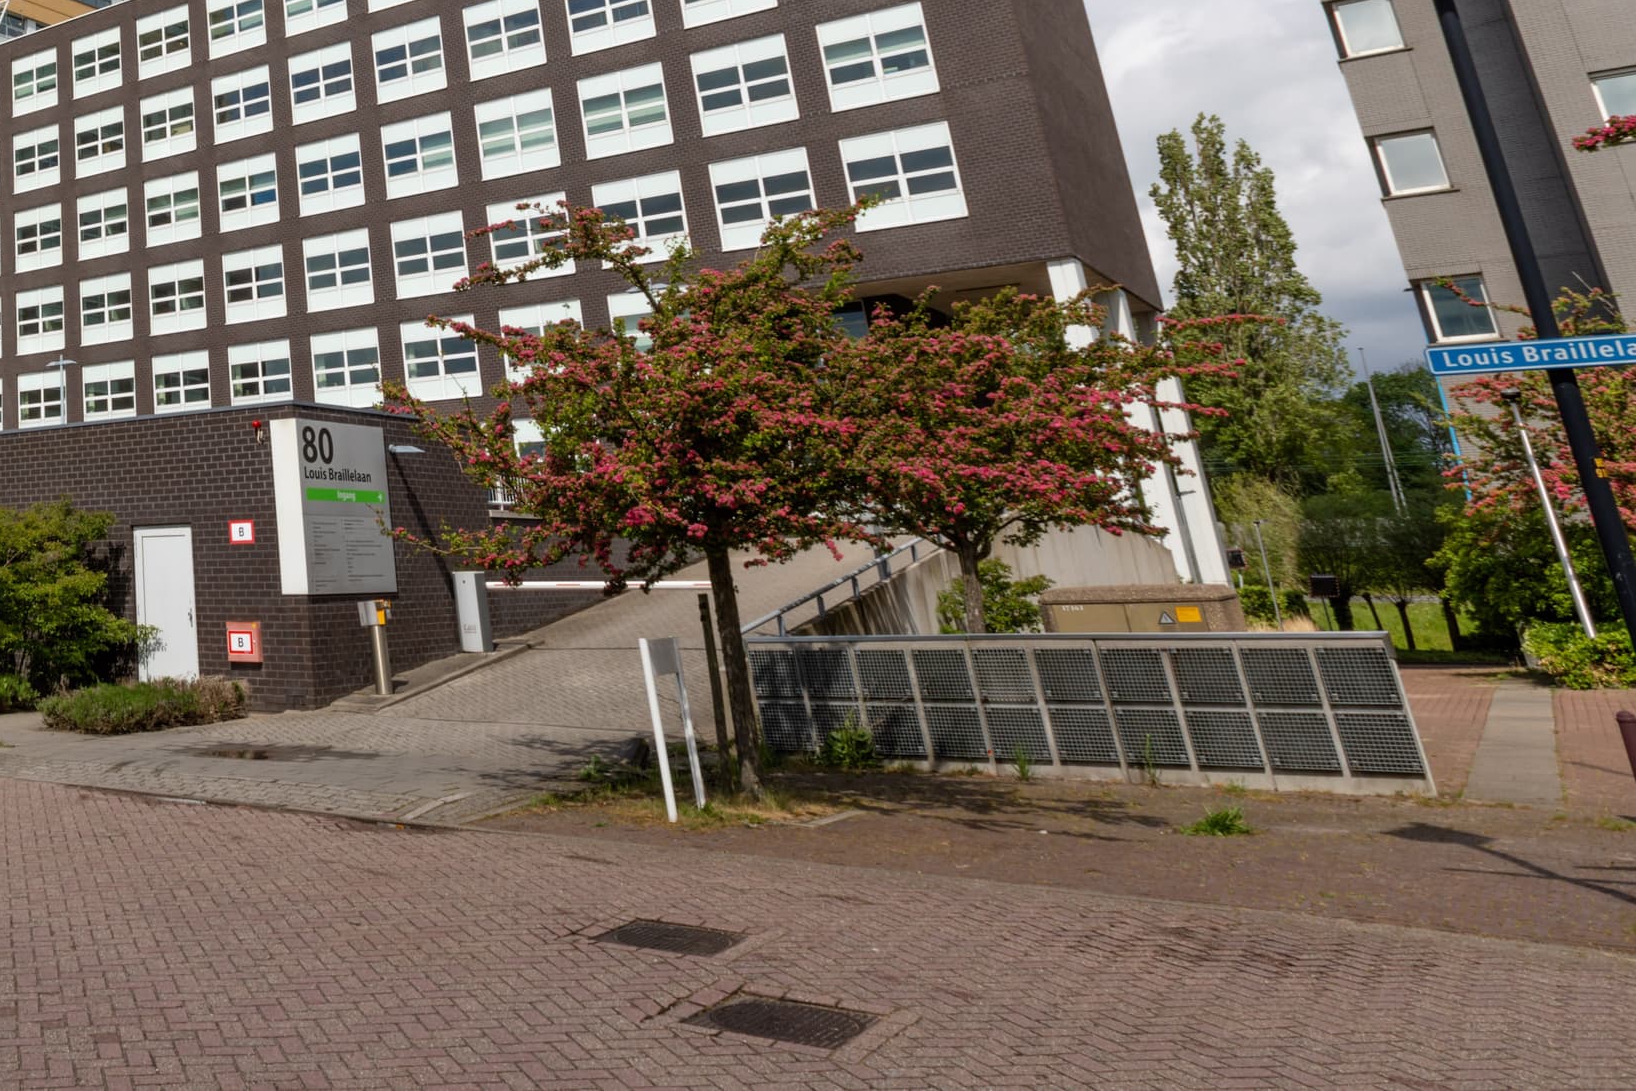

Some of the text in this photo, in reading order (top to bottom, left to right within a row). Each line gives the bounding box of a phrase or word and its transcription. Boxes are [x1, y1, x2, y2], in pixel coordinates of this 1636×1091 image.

[1443, 348, 1514, 367] Louis
[302, 426, 334, 464] 80
[304, 466, 372, 483] Louis Braillelaan
